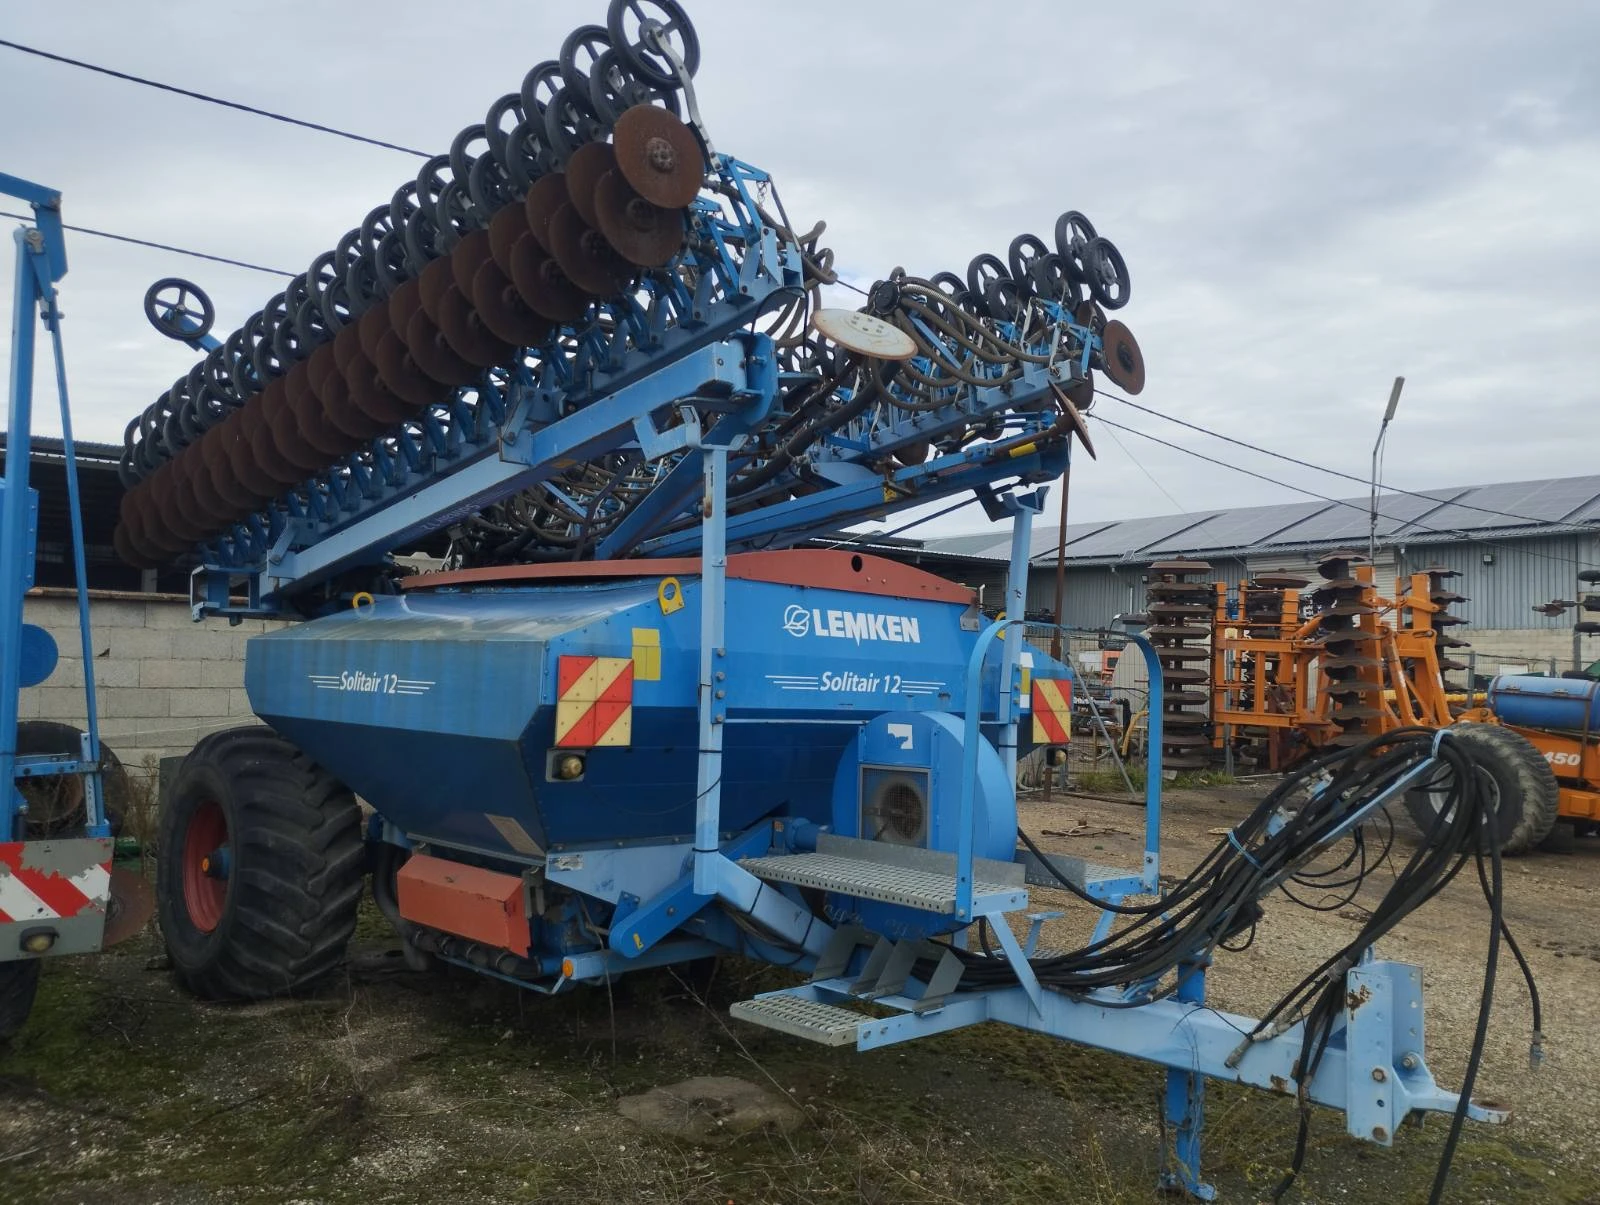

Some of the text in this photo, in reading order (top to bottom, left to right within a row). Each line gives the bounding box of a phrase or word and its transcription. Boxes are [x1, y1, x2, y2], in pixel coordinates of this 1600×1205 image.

[812, 608, 921, 647] LEMKEN
[339, 670, 398, 694] Solitair 12
[819, 671, 902, 694] Solitair 12
